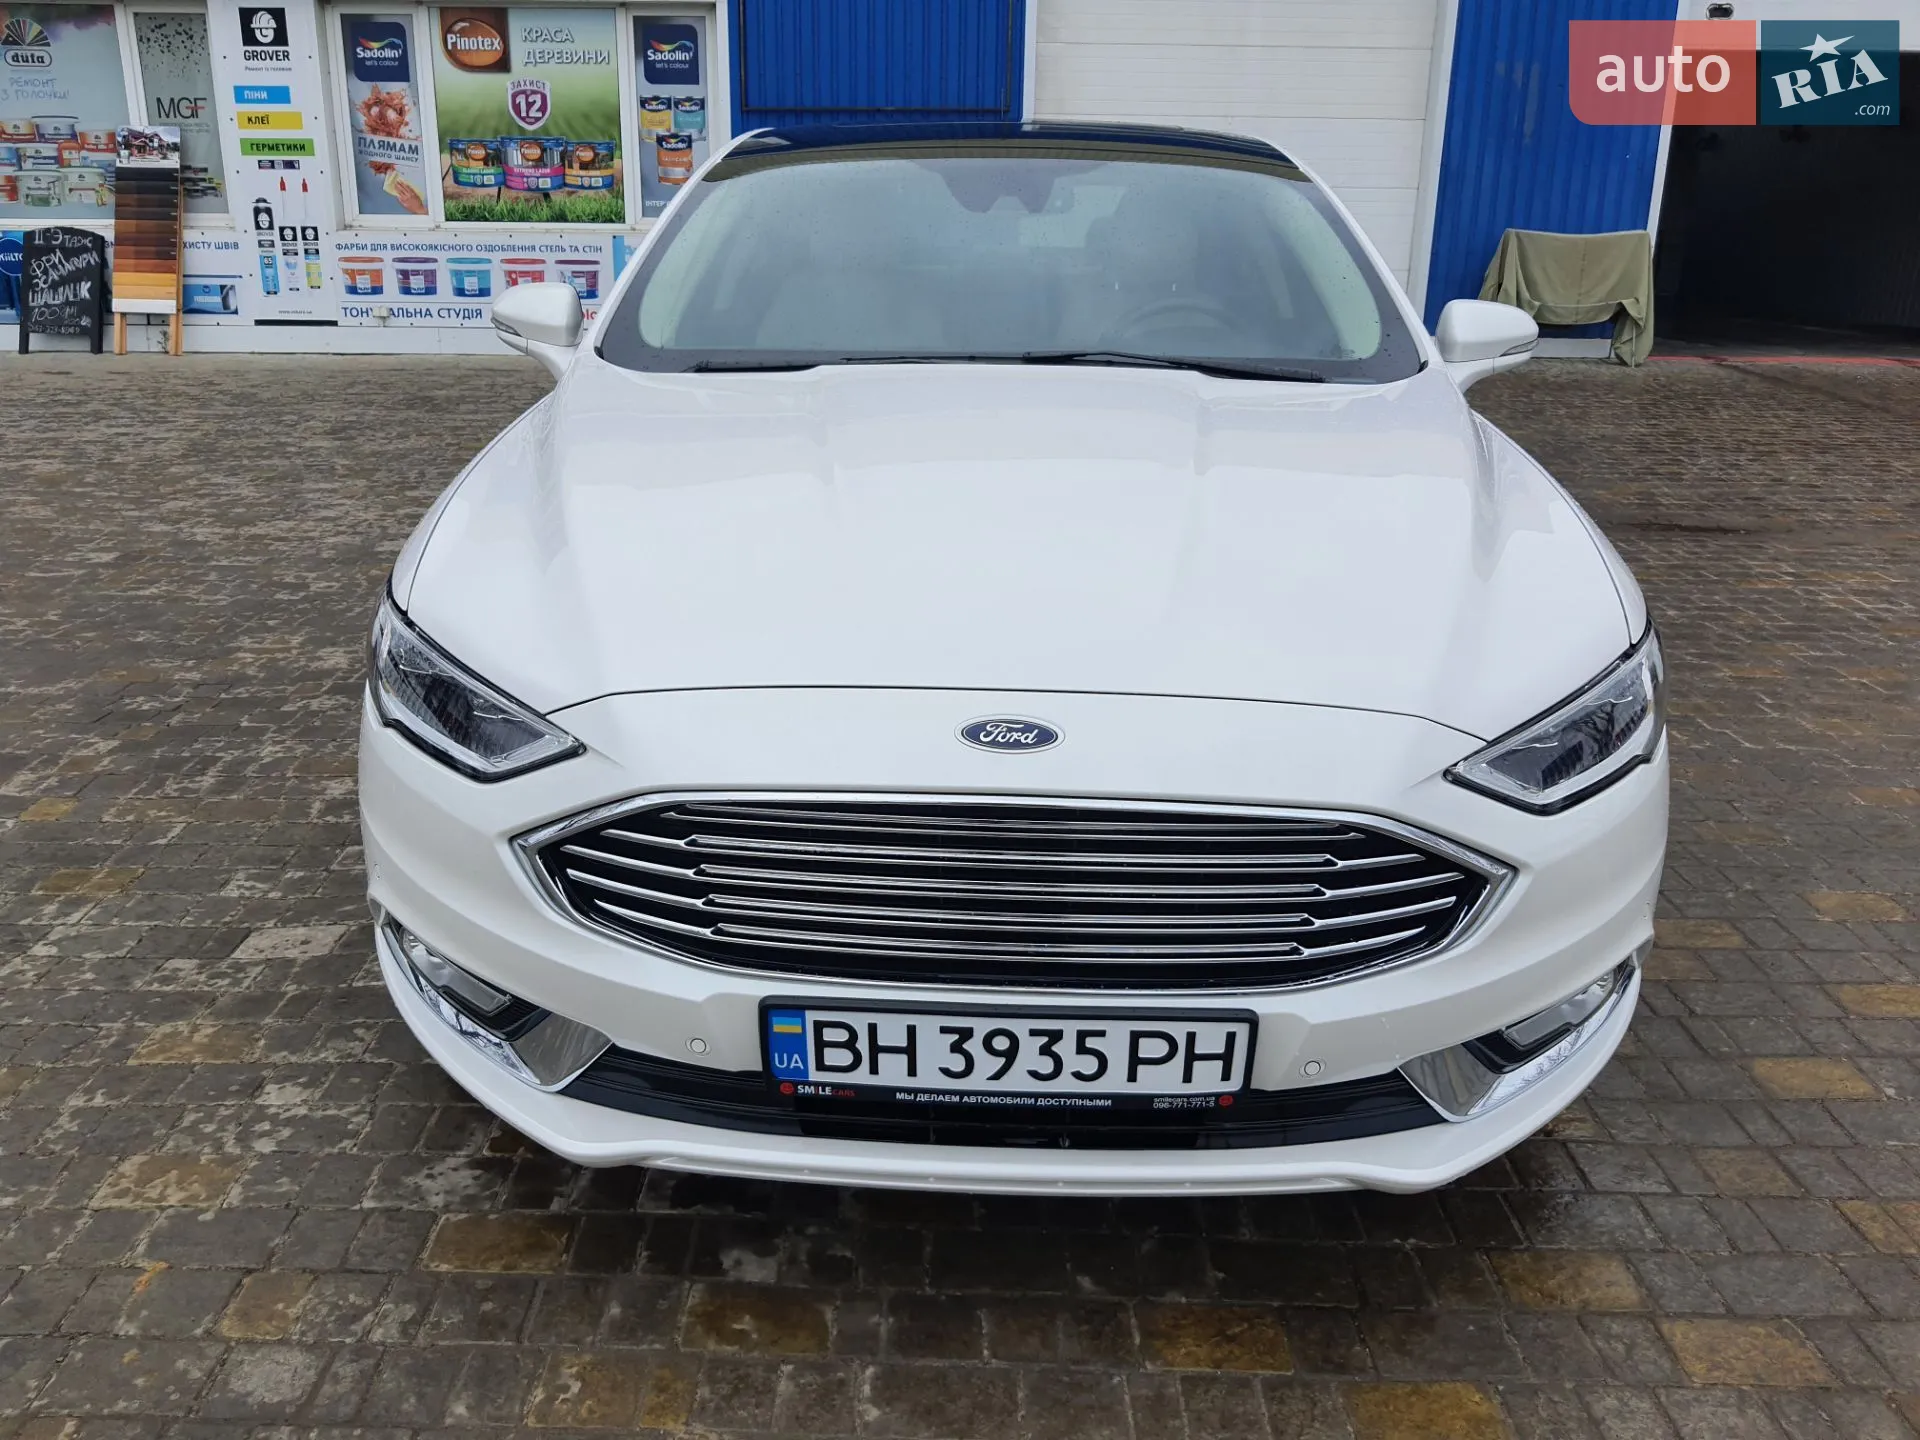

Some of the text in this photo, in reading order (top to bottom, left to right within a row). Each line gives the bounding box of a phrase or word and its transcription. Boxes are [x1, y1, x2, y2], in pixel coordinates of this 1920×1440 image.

[521, 27, 574, 43] КРАСА
[446, 33, 502, 51] Pinotex
[11, 52, 46, 64] düfa
[243, 49, 291, 62] GROVER
[356, 47, 399, 58] Sadolin
[524, 49, 610, 66] ДЕРЕВИНИ
[647, 49, 690, 60] Sadolin
[511, 79, 546, 91] ЗАХИСТ
[244, 90, 269, 100] ПІНИ
[156, 97, 207, 119] MGF
[515, 93, 543, 118] 12
[247, 114, 270, 125] КЛЕЇ
[250, 143, 306, 153] ГЕРМЕТИКИ
[358, 136, 419, 156] ПЛЯМАМ
[183, 241, 240, 250] ХИСТУ ШВІВ
[335, 243, 602, 254] ФАРБИ ДЛЯ ВИСОКОЯКІСНОГО ОЗДОБЛЕННЯ СТЕЛЬ ТА СТІН
[341, 307, 482, 320] ТОНАЛЬНА СТУДІЯ
[979, 722, 1039, 744] Ford
[937, 1025, 1109, 1081] 3935
[774, 1052, 804, 1070] UA
[896, 1091, 1112, 1106] МЫ ДЕЛАЕМ АВТОМОБИЛИ ДОСТУПНЫМИ
